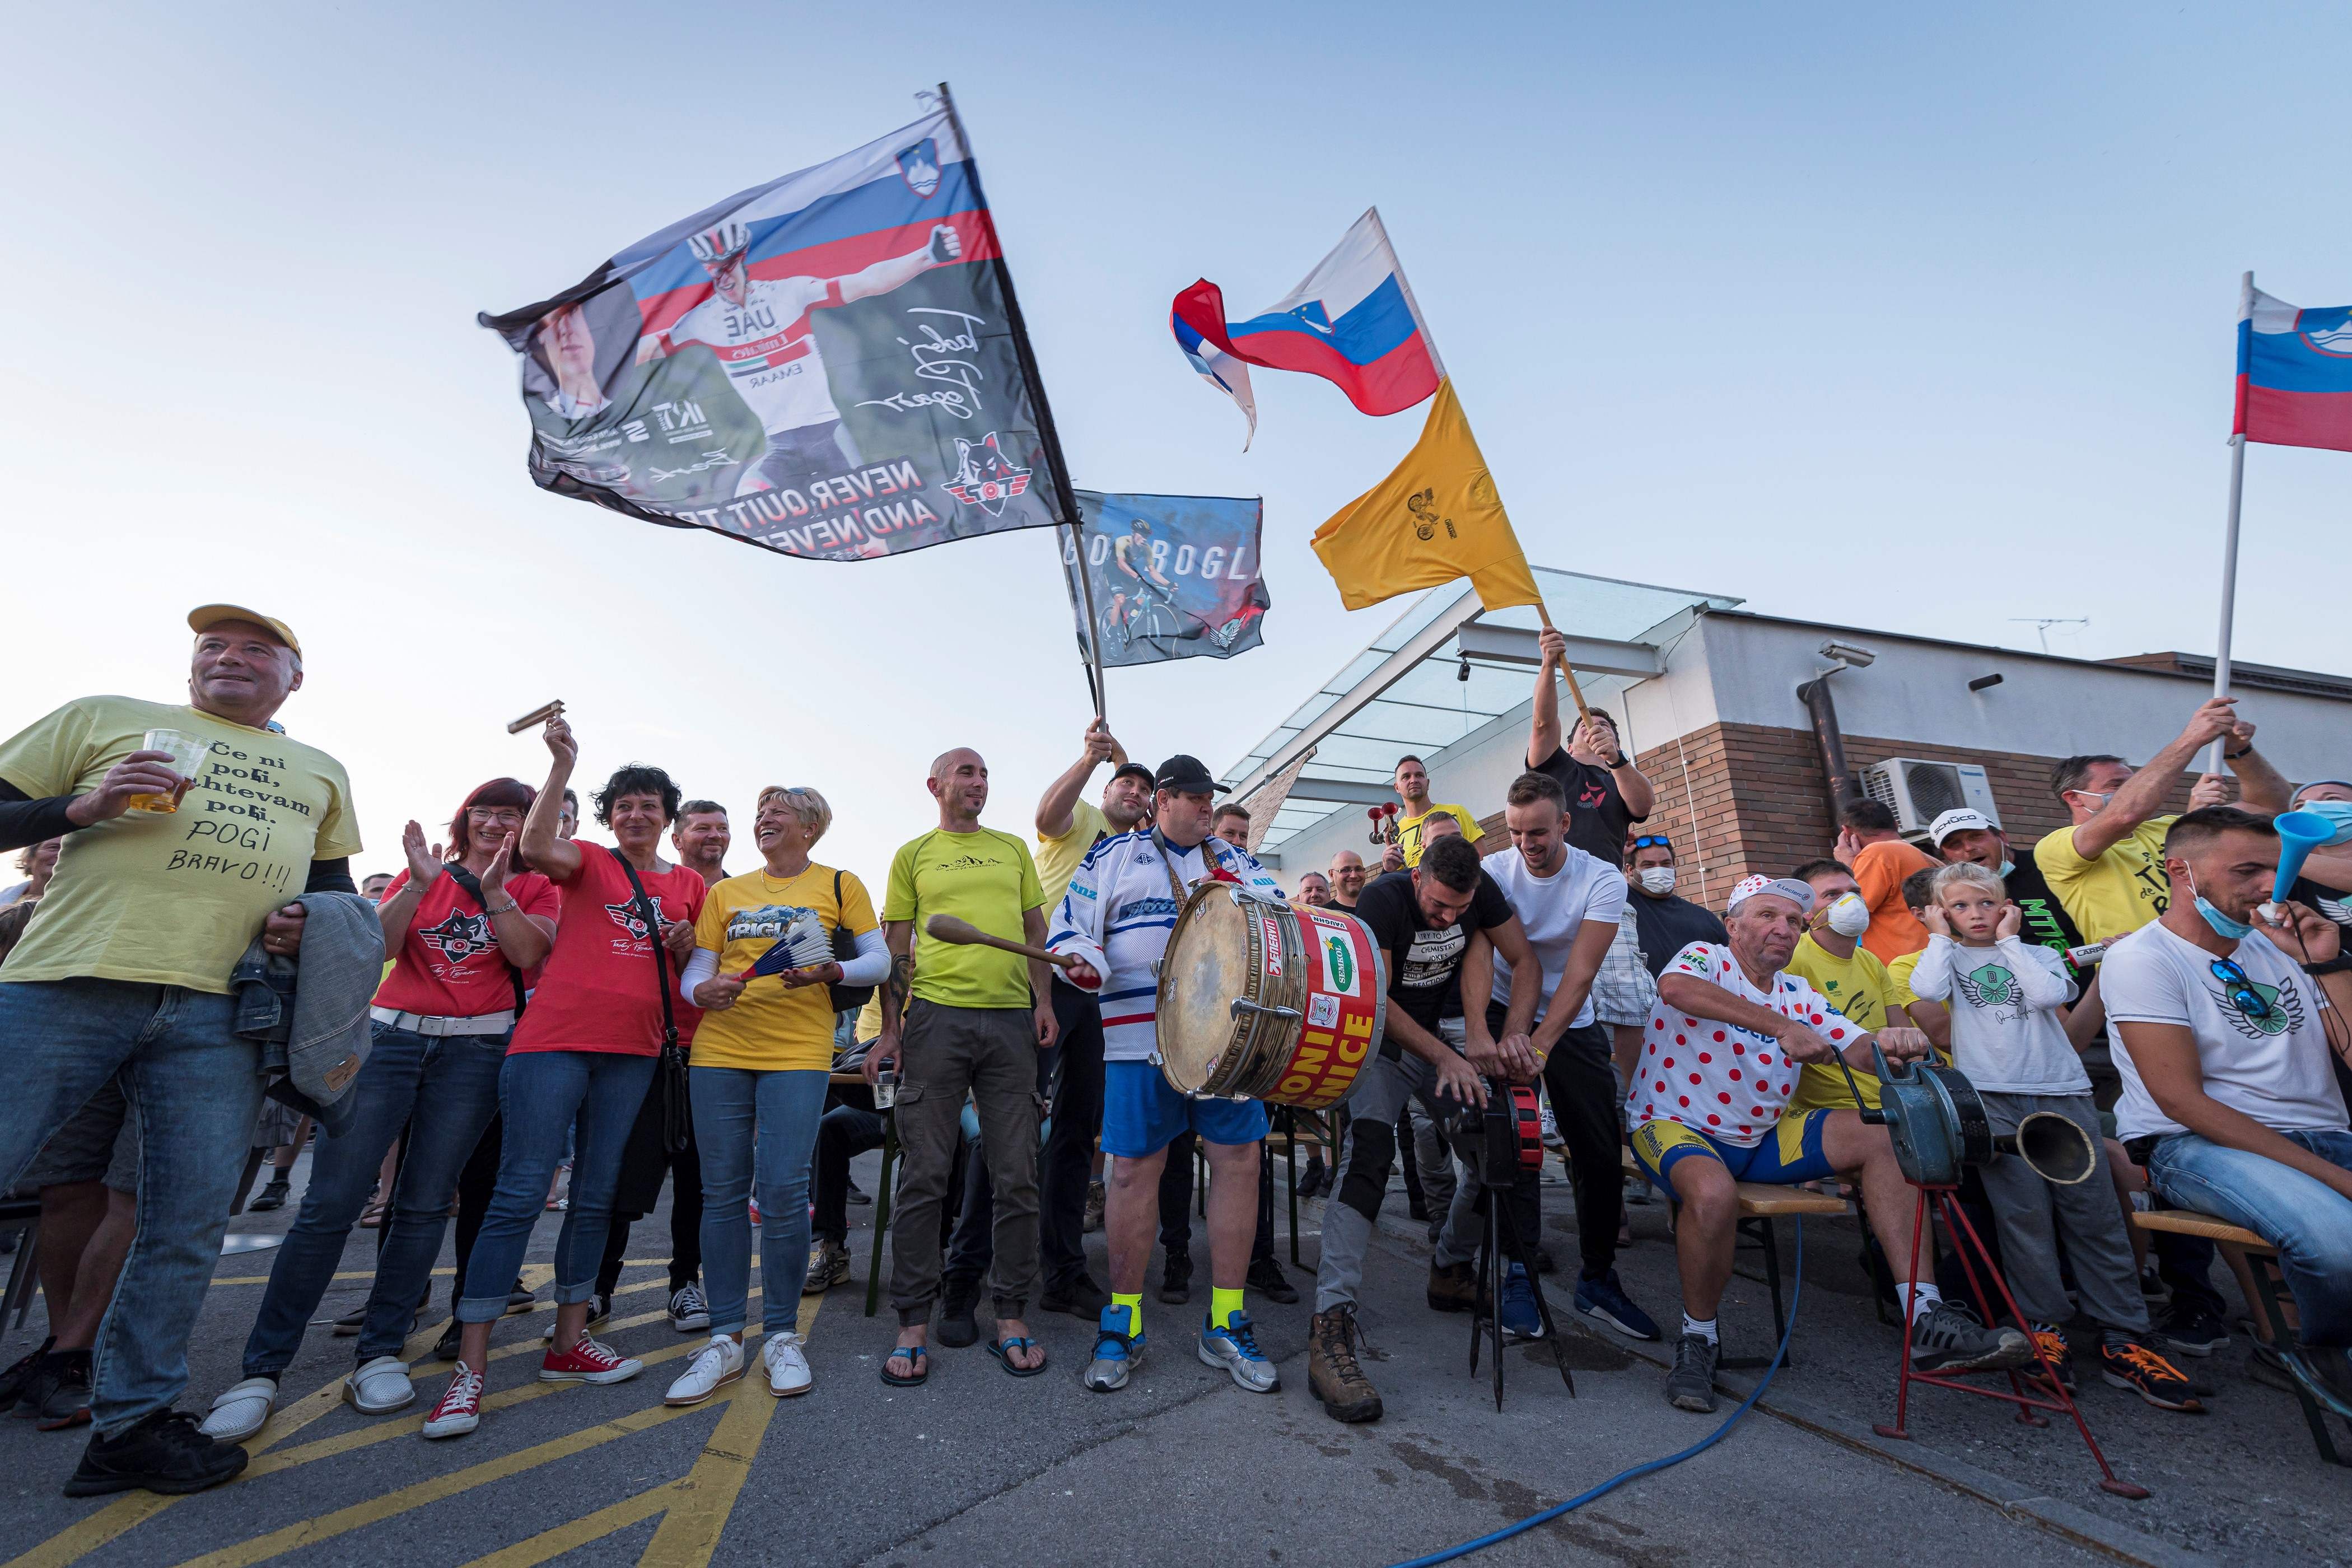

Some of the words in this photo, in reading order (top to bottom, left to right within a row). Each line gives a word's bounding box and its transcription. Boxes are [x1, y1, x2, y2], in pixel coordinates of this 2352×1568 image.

[1065, 533, 1113, 566] GO
[1145, 539, 1262, 580] ROGL
[210, 740, 248, 760] Če
[259, 756, 286, 770] ni
[165, 850, 291, 893] BRAVO!!!
[1777, 884, 1803, 897] E.Leclerc
[1265, 918, 1281, 960] ENERVIT
[1313, 916, 1345, 928] VAUGHN
[1335, 945, 1346, 984] SEMKOL
[1421, 941, 1456, 953] CHEMISTRY
[1302, 1013, 1373, 1110] ENICE
[1642, 1124, 1663, 1158] Slovenija
